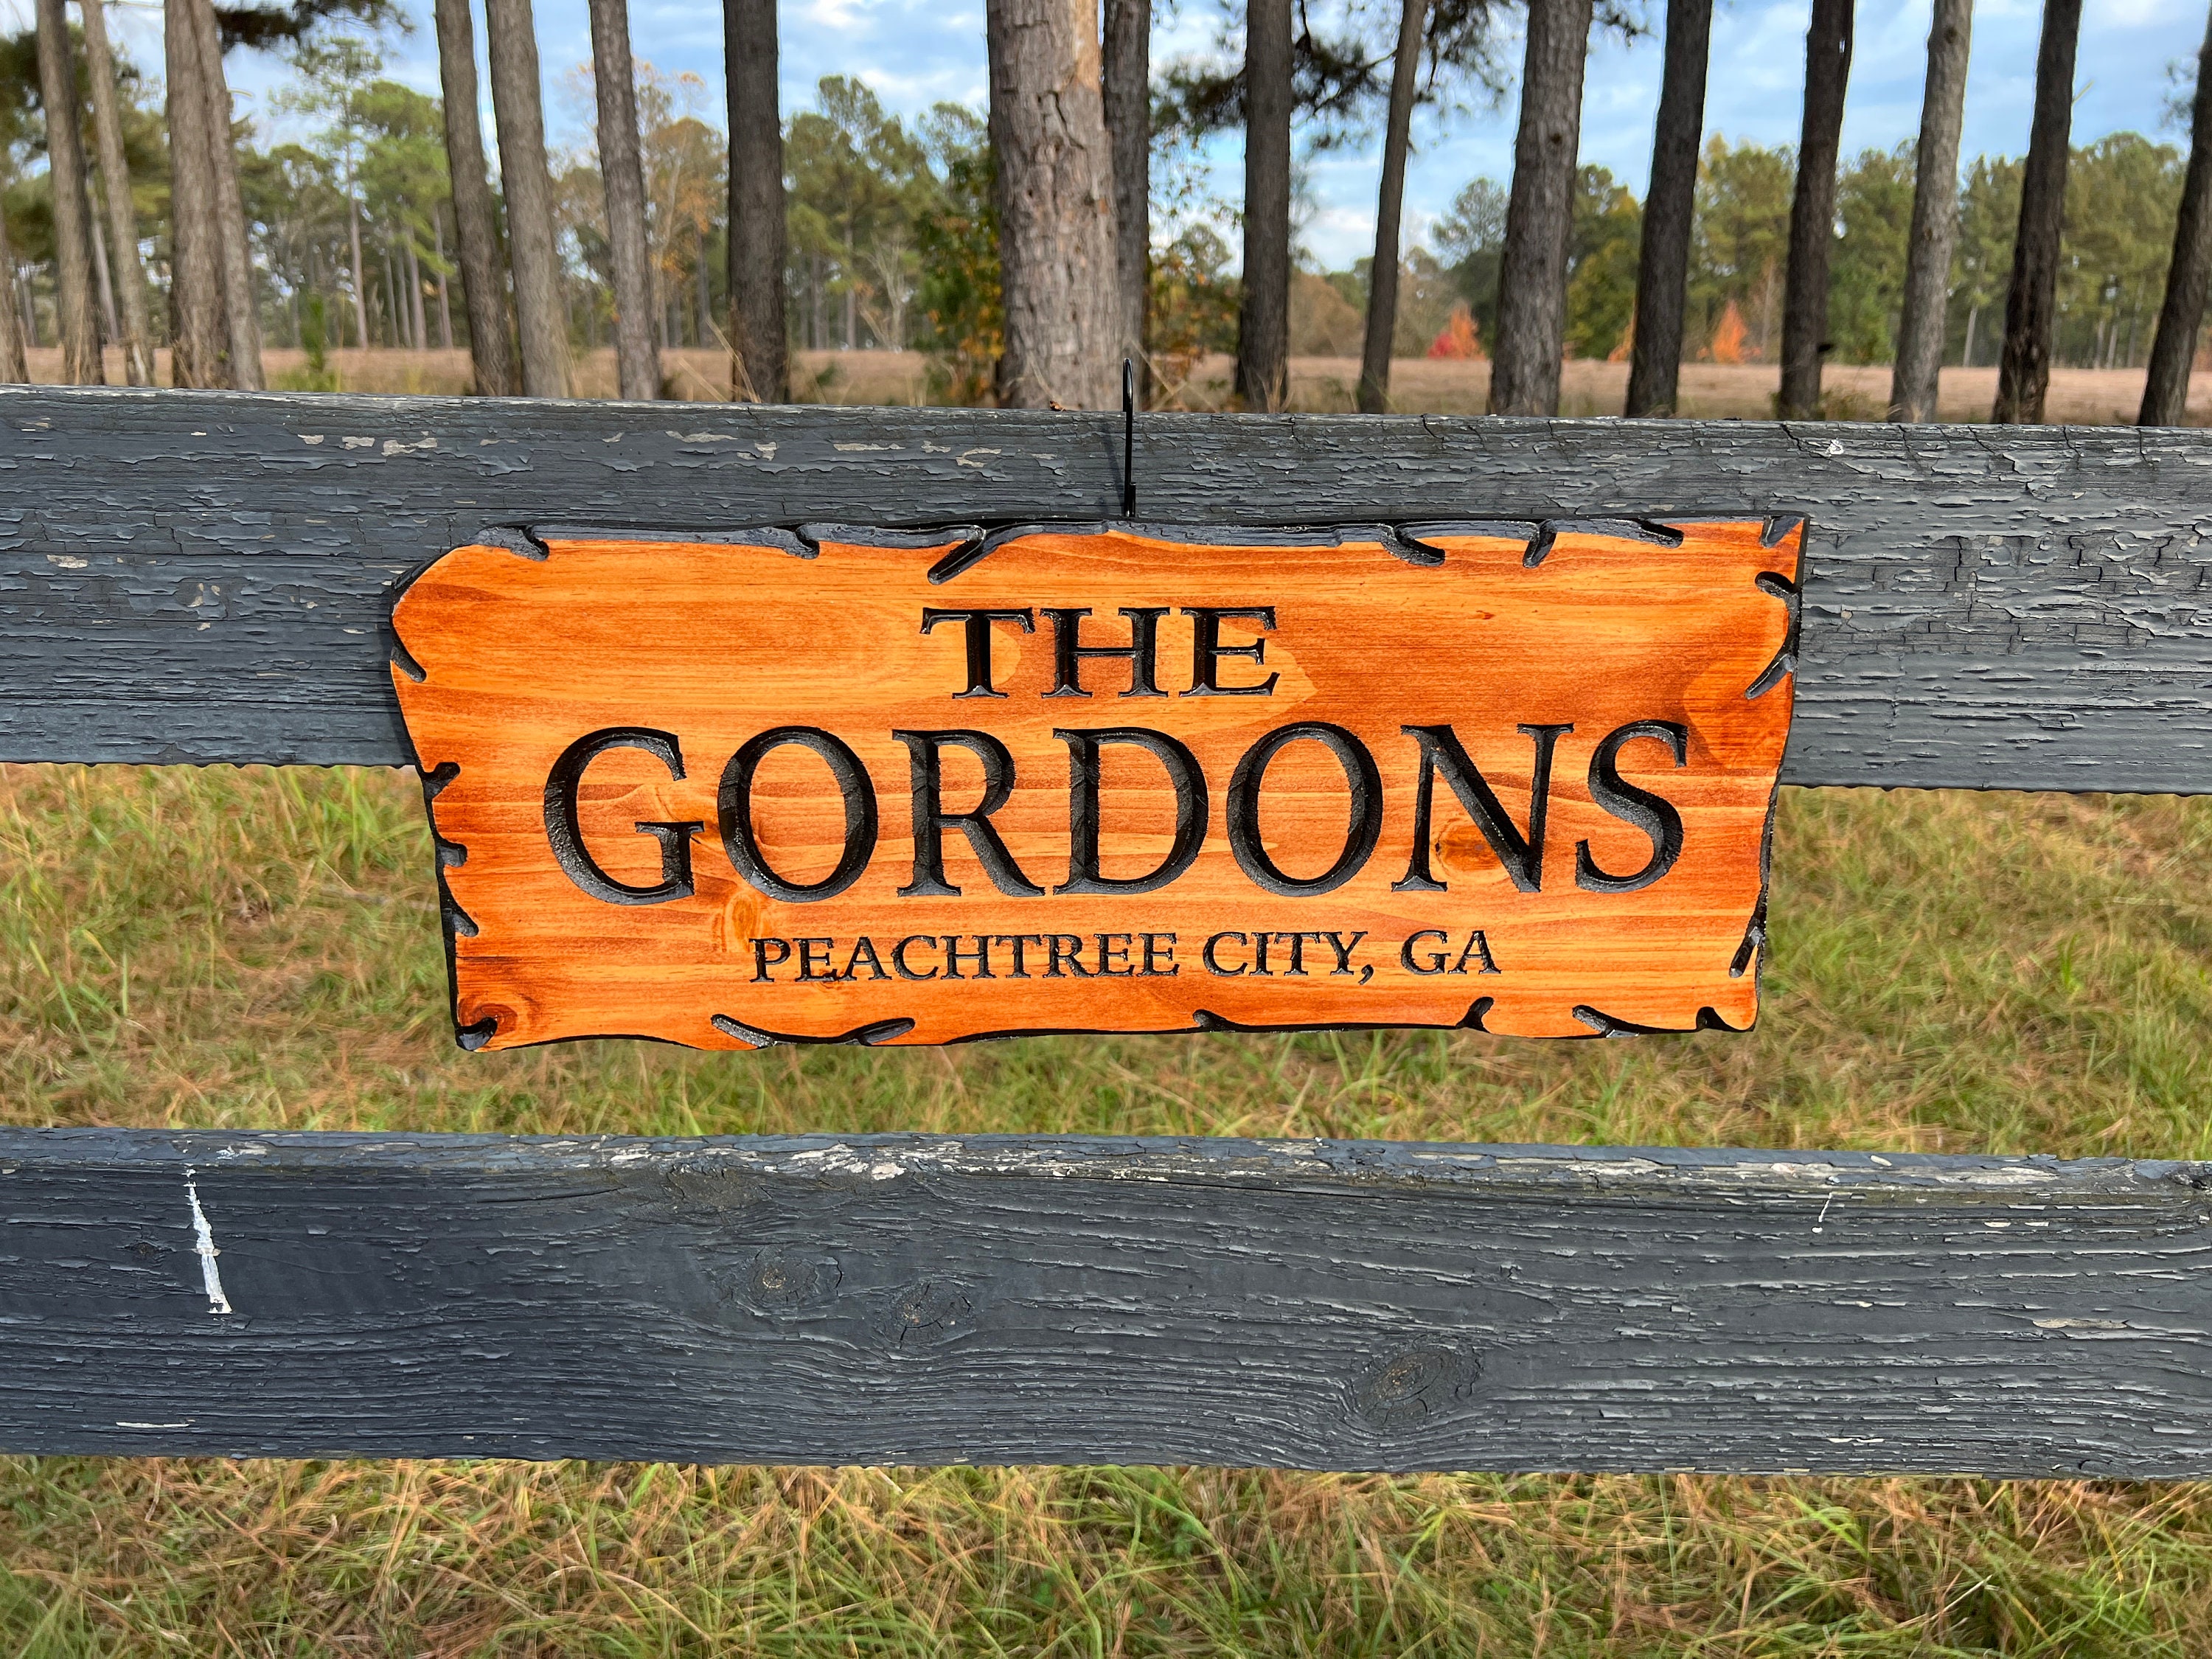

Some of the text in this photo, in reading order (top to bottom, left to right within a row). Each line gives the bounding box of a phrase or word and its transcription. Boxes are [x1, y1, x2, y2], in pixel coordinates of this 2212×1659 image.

[919, 605, 1281, 700] THE
[543, 719, 1690, 904] GORDONS
[748, 929, 1503, 984] PEACHTREE CITY, GA
